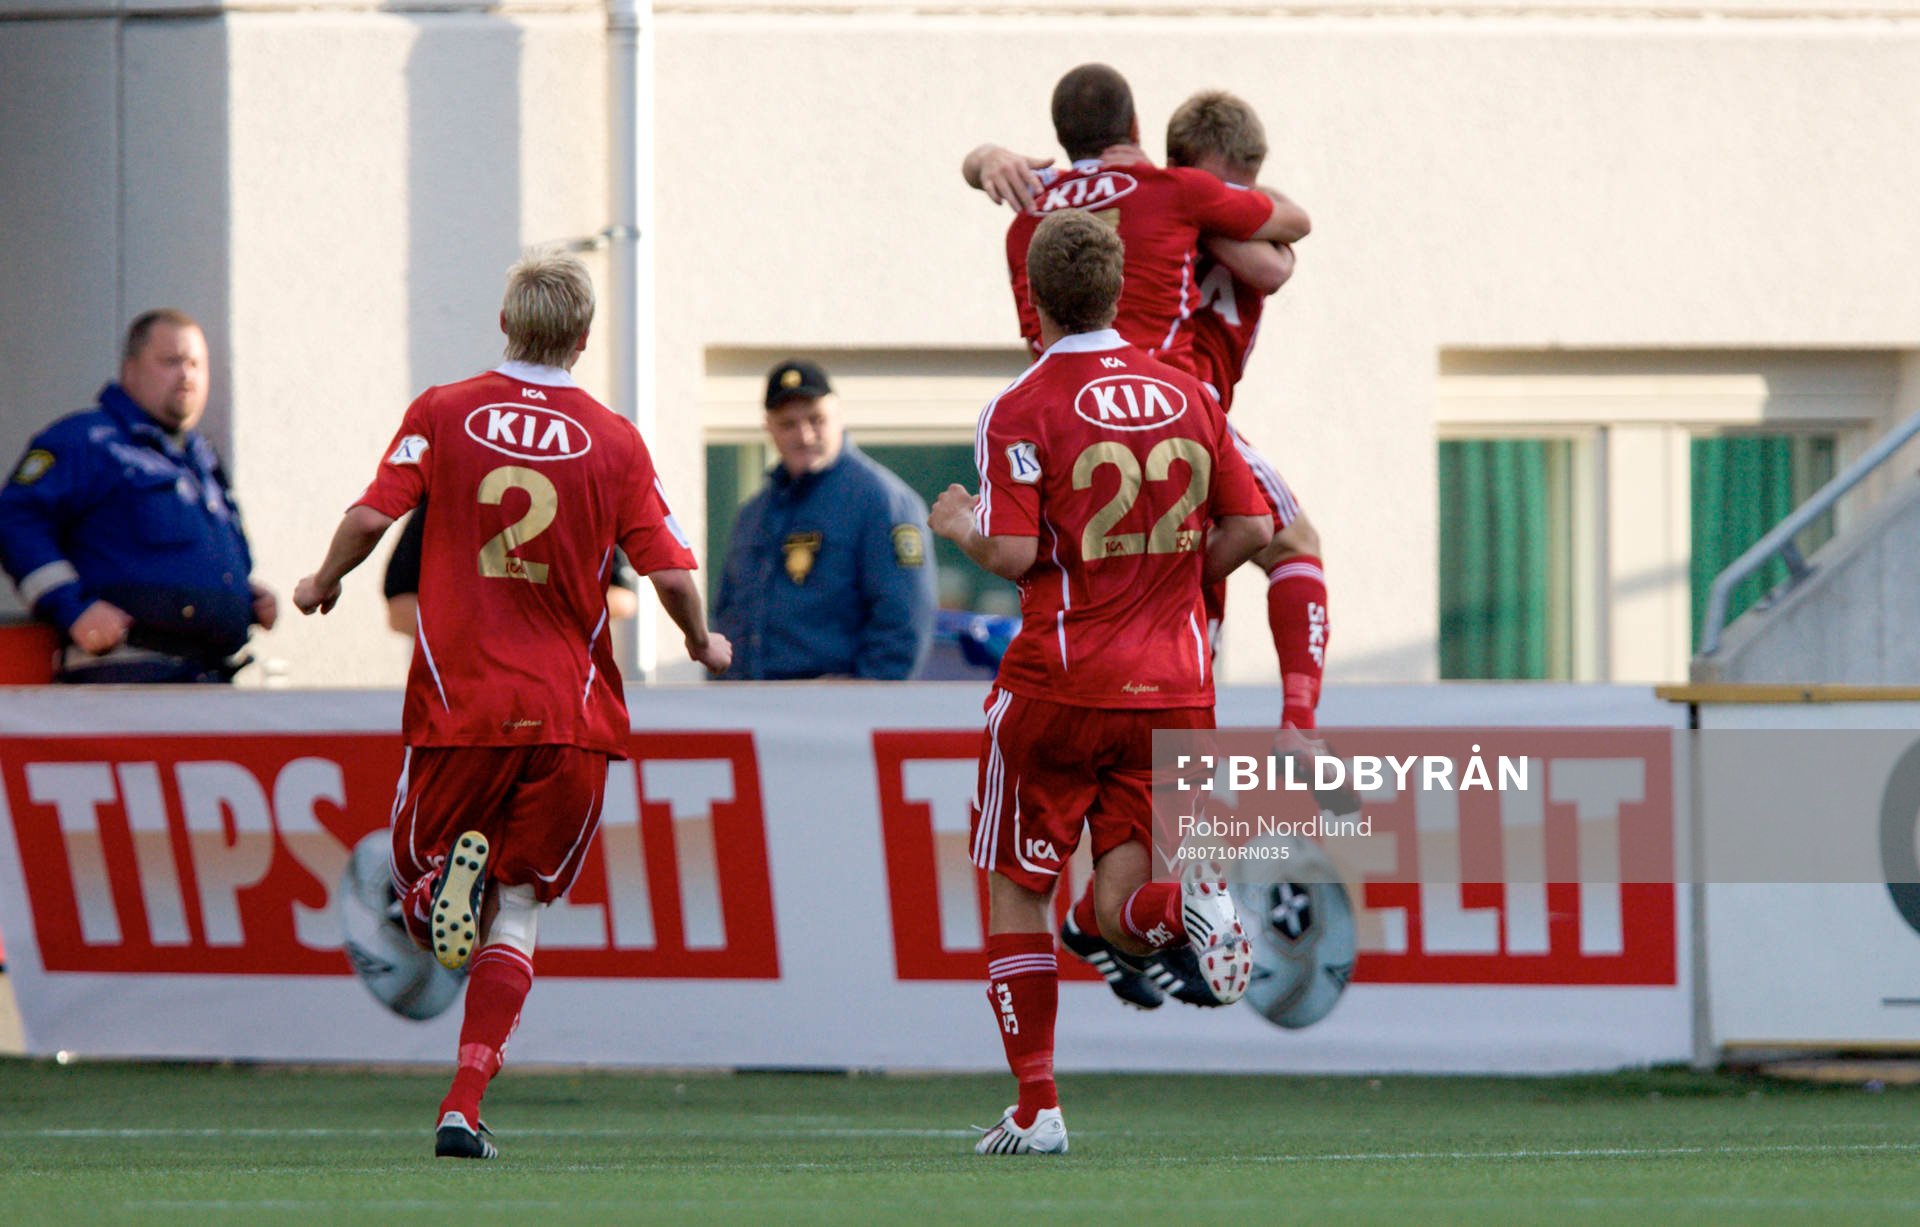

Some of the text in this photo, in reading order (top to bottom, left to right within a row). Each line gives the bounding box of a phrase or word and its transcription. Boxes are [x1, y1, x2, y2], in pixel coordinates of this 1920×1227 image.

[1043, 176, 1116, 211] KIA
[1100, 357, 1127, 368] ICA
[521, 388, 547, 400] ICA
[1090, 384, 1174, 420] KIA
[487, 409, 570, 453] KIA
[1072, 437, 1211, 562] 22
[477, 465, 558, 584] 2
[24, 757, 352, 949] TIPS
[1026, 838, 1060, 862] ICA
